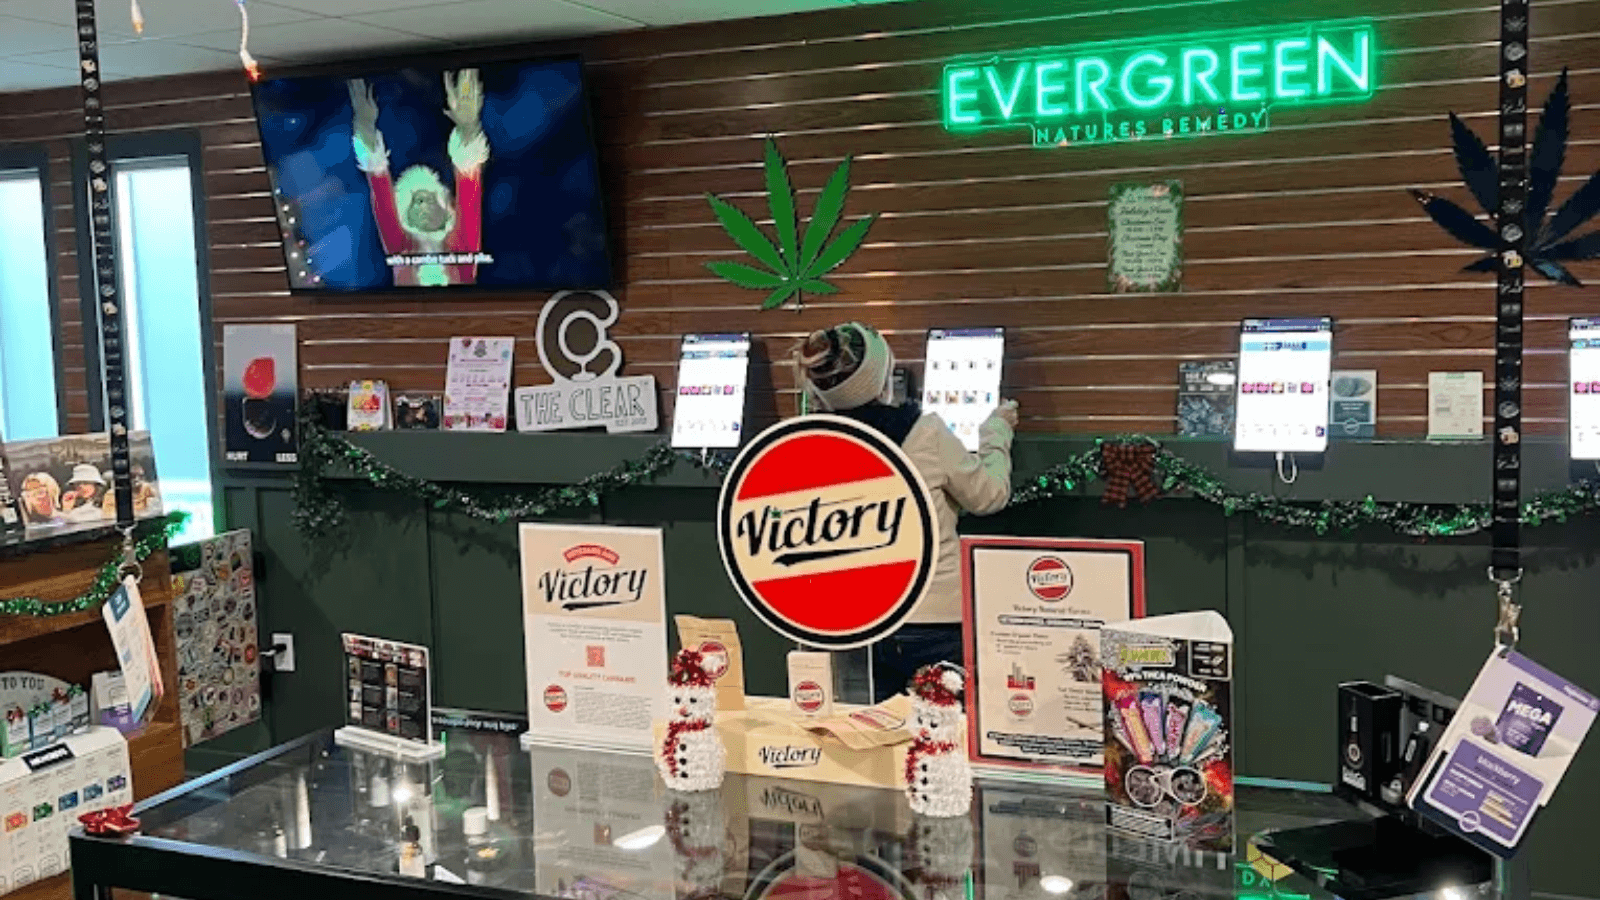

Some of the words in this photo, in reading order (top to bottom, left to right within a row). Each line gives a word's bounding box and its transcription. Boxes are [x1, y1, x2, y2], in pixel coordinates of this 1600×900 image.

[947, 31, 1370, 123] EVERGREEN
[1036, 119, 1147, 144] NATURES
[1162, 111, 1265, 134] REMEDY
[386, 255, 404, 265] with
[412, 254, 438, 264] combo
[439, 254, 456, 264] tuck
[458, 253, 473, 264] and
[520, 390, 563, 425] THE
[568, 384, 645, 420] CLEAR
[736, 496, 907, 567] Victory
[538, 566, 648, 611] Victory
[1030, 572, 1068, 586] Victory
[1012, 604, 1037, 614] Victory
[1, 676, 18, 690] TO
[20, 677, 45, 691] YOU
[1141, 669, 1166, 681] THCA
[1506, 700, 1552, 726] MEGA
[758, 744, 822, 769] Victory
